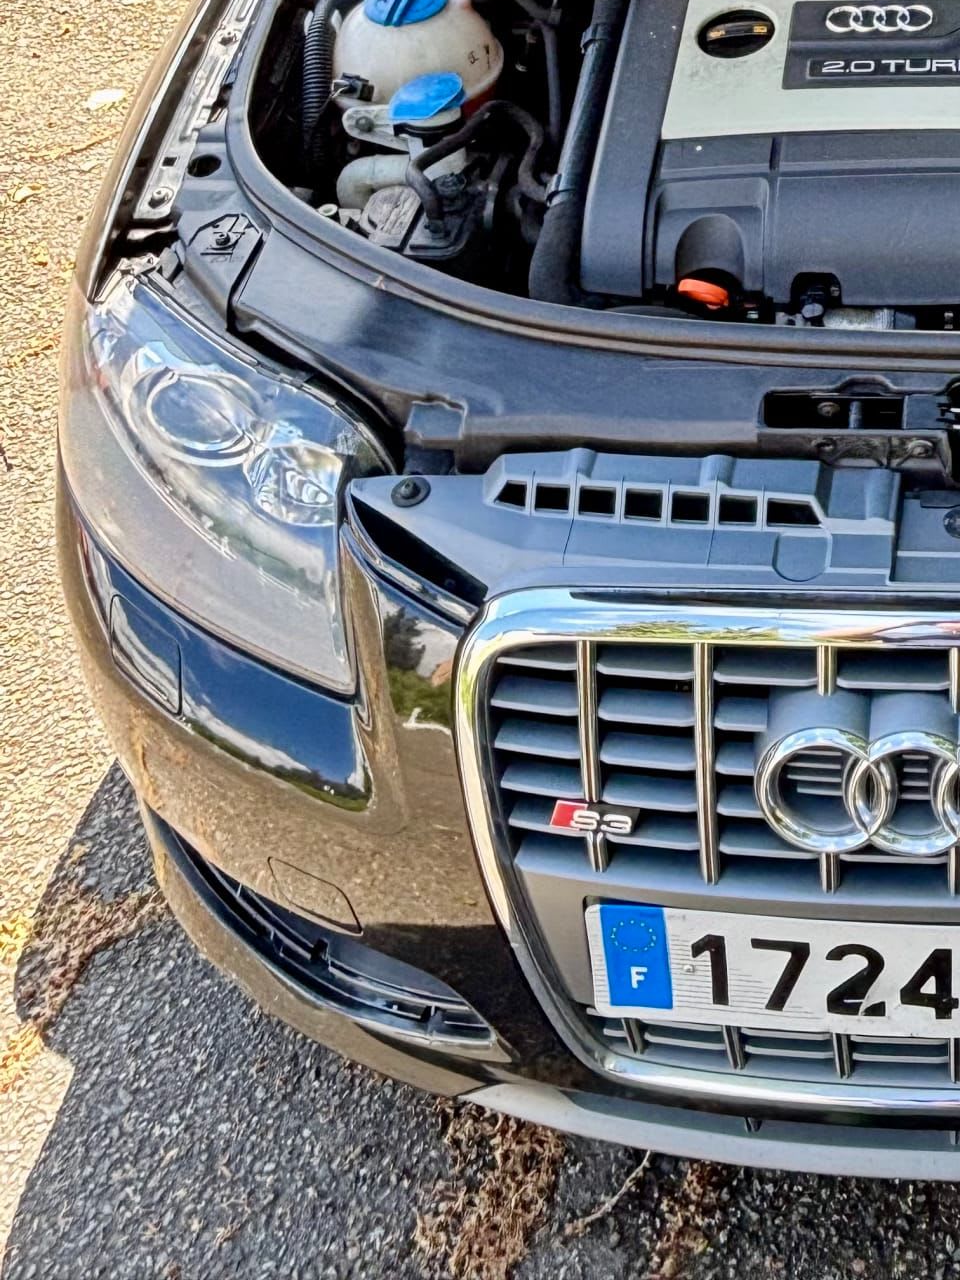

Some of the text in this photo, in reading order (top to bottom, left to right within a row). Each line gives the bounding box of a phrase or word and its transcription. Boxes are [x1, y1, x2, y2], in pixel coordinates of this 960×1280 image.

[822, 60, 875, 73] 2.0
[570, 809, 632, 834] S3
[630, 966, 646, 990] F
[690, 933, 960, 1020] 1724
